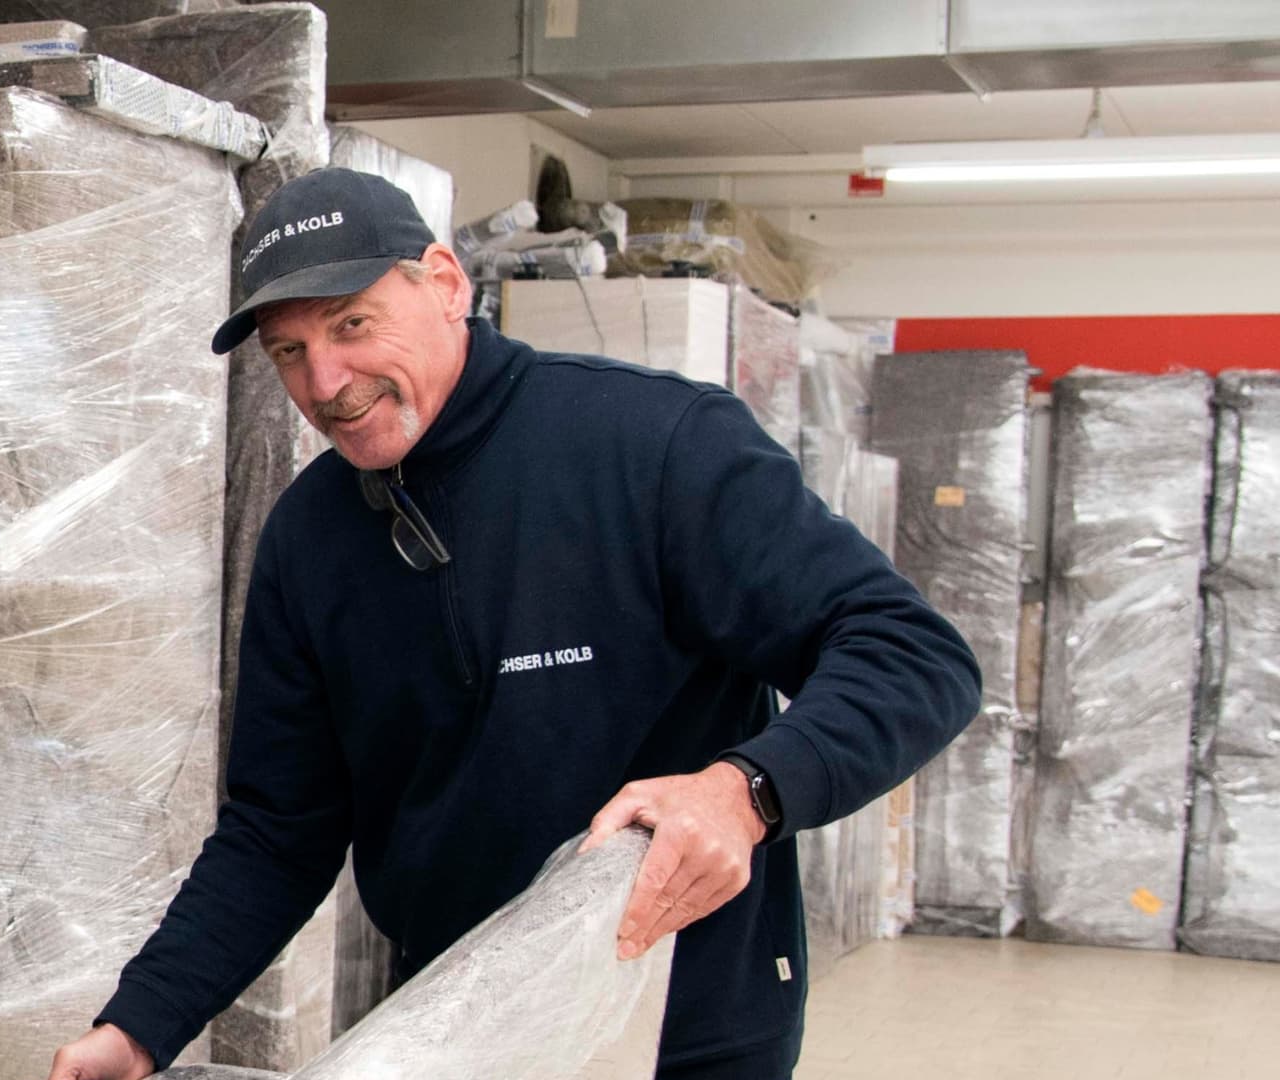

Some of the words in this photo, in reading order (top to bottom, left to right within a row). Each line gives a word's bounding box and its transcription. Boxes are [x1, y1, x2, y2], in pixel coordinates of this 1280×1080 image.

[284, 223, 296, 237] &
[297, 211, 344, 234] KOLB
[544, 652, 554, 666] &
[555, 646, 593, 665] KOLB
